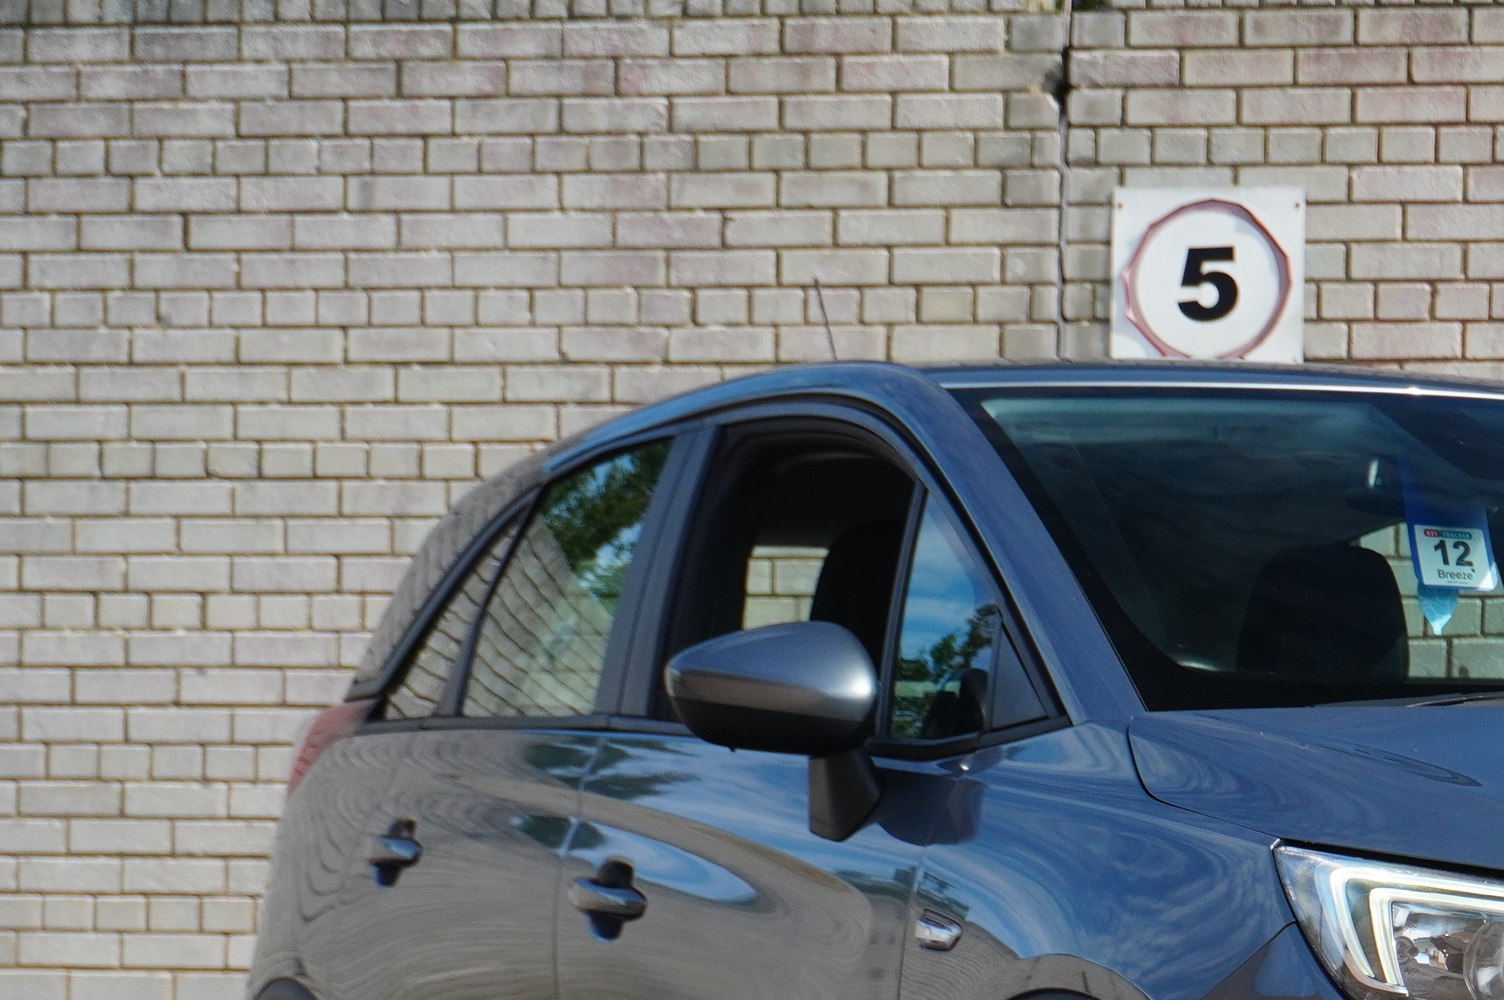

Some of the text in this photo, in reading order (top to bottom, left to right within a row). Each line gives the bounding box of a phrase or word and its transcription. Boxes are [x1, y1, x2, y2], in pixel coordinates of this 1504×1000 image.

[1178, 247, 1238, 322] 5
[1434, 539, 1474, 566] 12
[1438, 569, 1473, 580] Breeze
